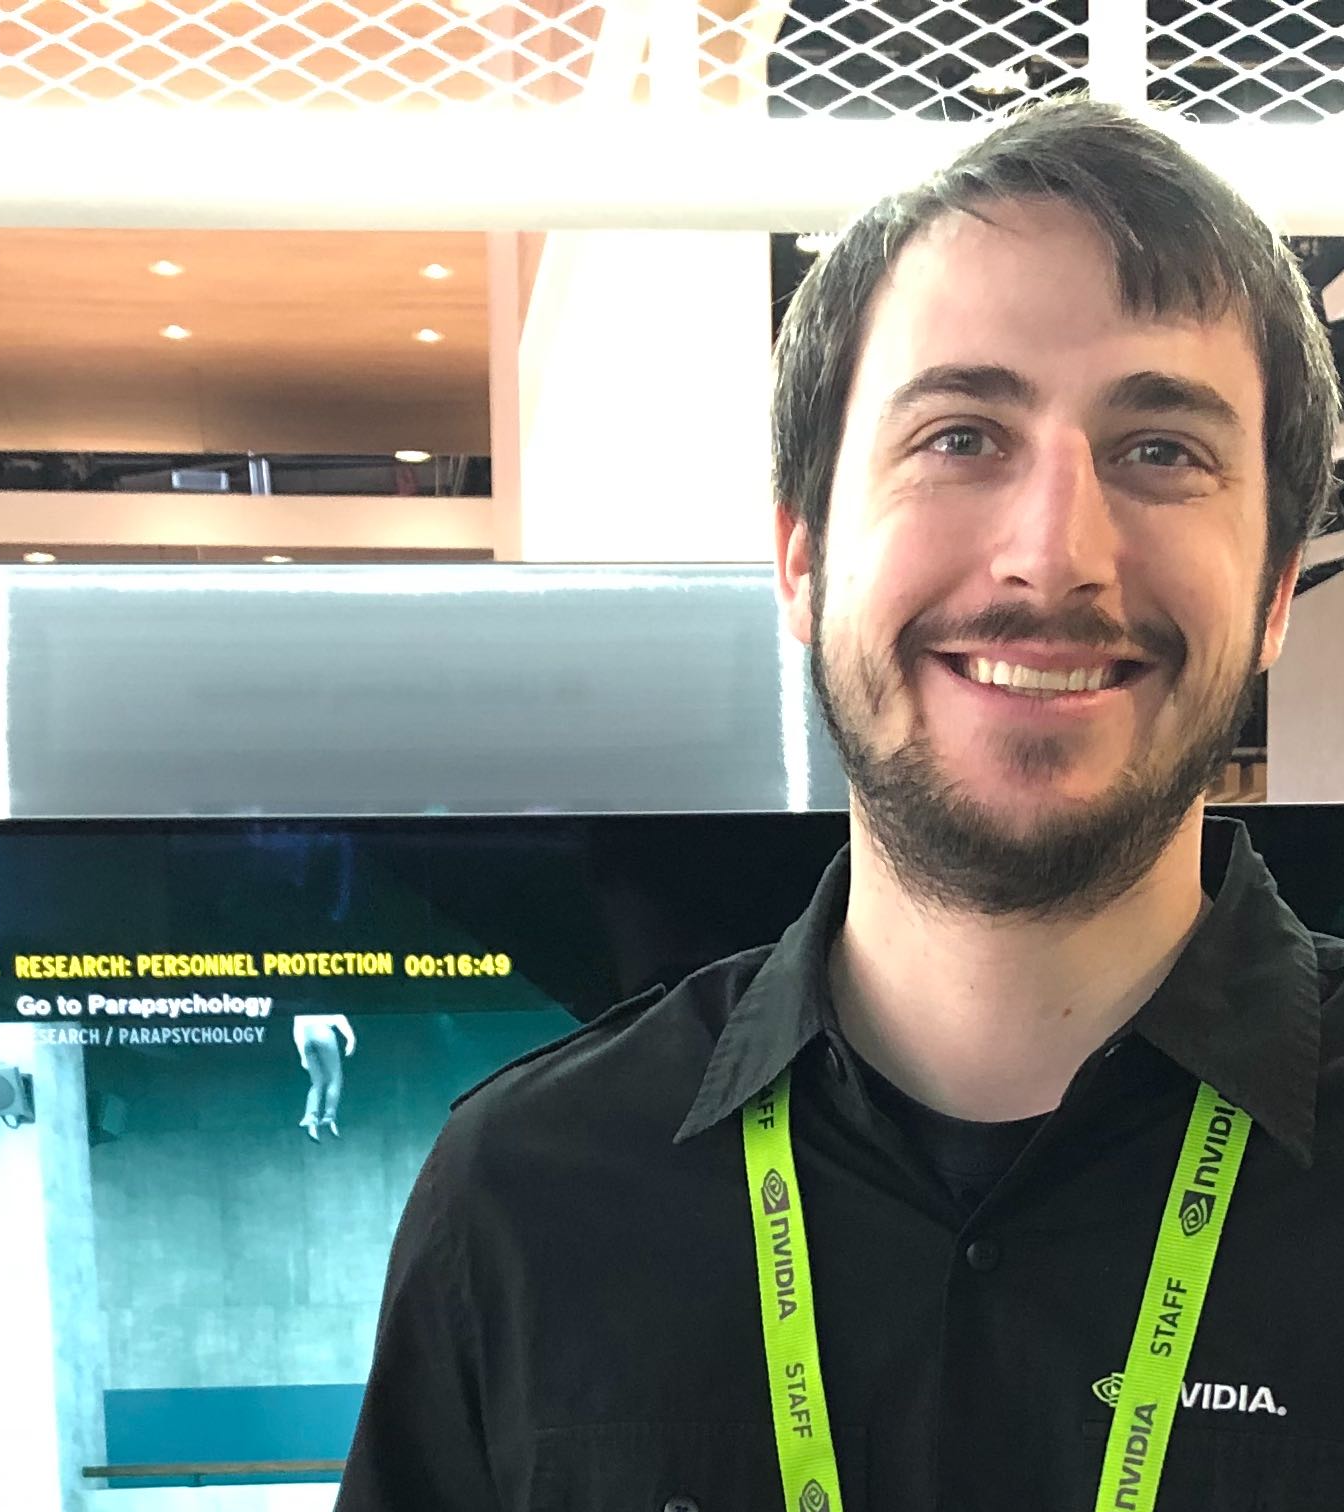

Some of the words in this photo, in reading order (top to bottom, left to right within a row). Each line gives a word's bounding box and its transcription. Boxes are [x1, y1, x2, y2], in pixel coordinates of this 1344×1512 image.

[15, 955, 132, 979] RESEARCH:
[137, 954, 258, 978] PERSONNEL
[264, 952, 393, 976] PROTECTION
[404, 953, 512, 977] 00:16:49
[16, 995, 52, 1016] Go
[57, 995, 83, 1016] to
[88, 993, 273, 1018] Parapsychology
[119, 1026, 265, 1045] PARAPSYCHOLOGY
[1193, 1105, 1237, 1188] NVIDI
[1150, 1276, 1188, 1358] STAFF
[785, 1362, 813, 1440] STAFF
